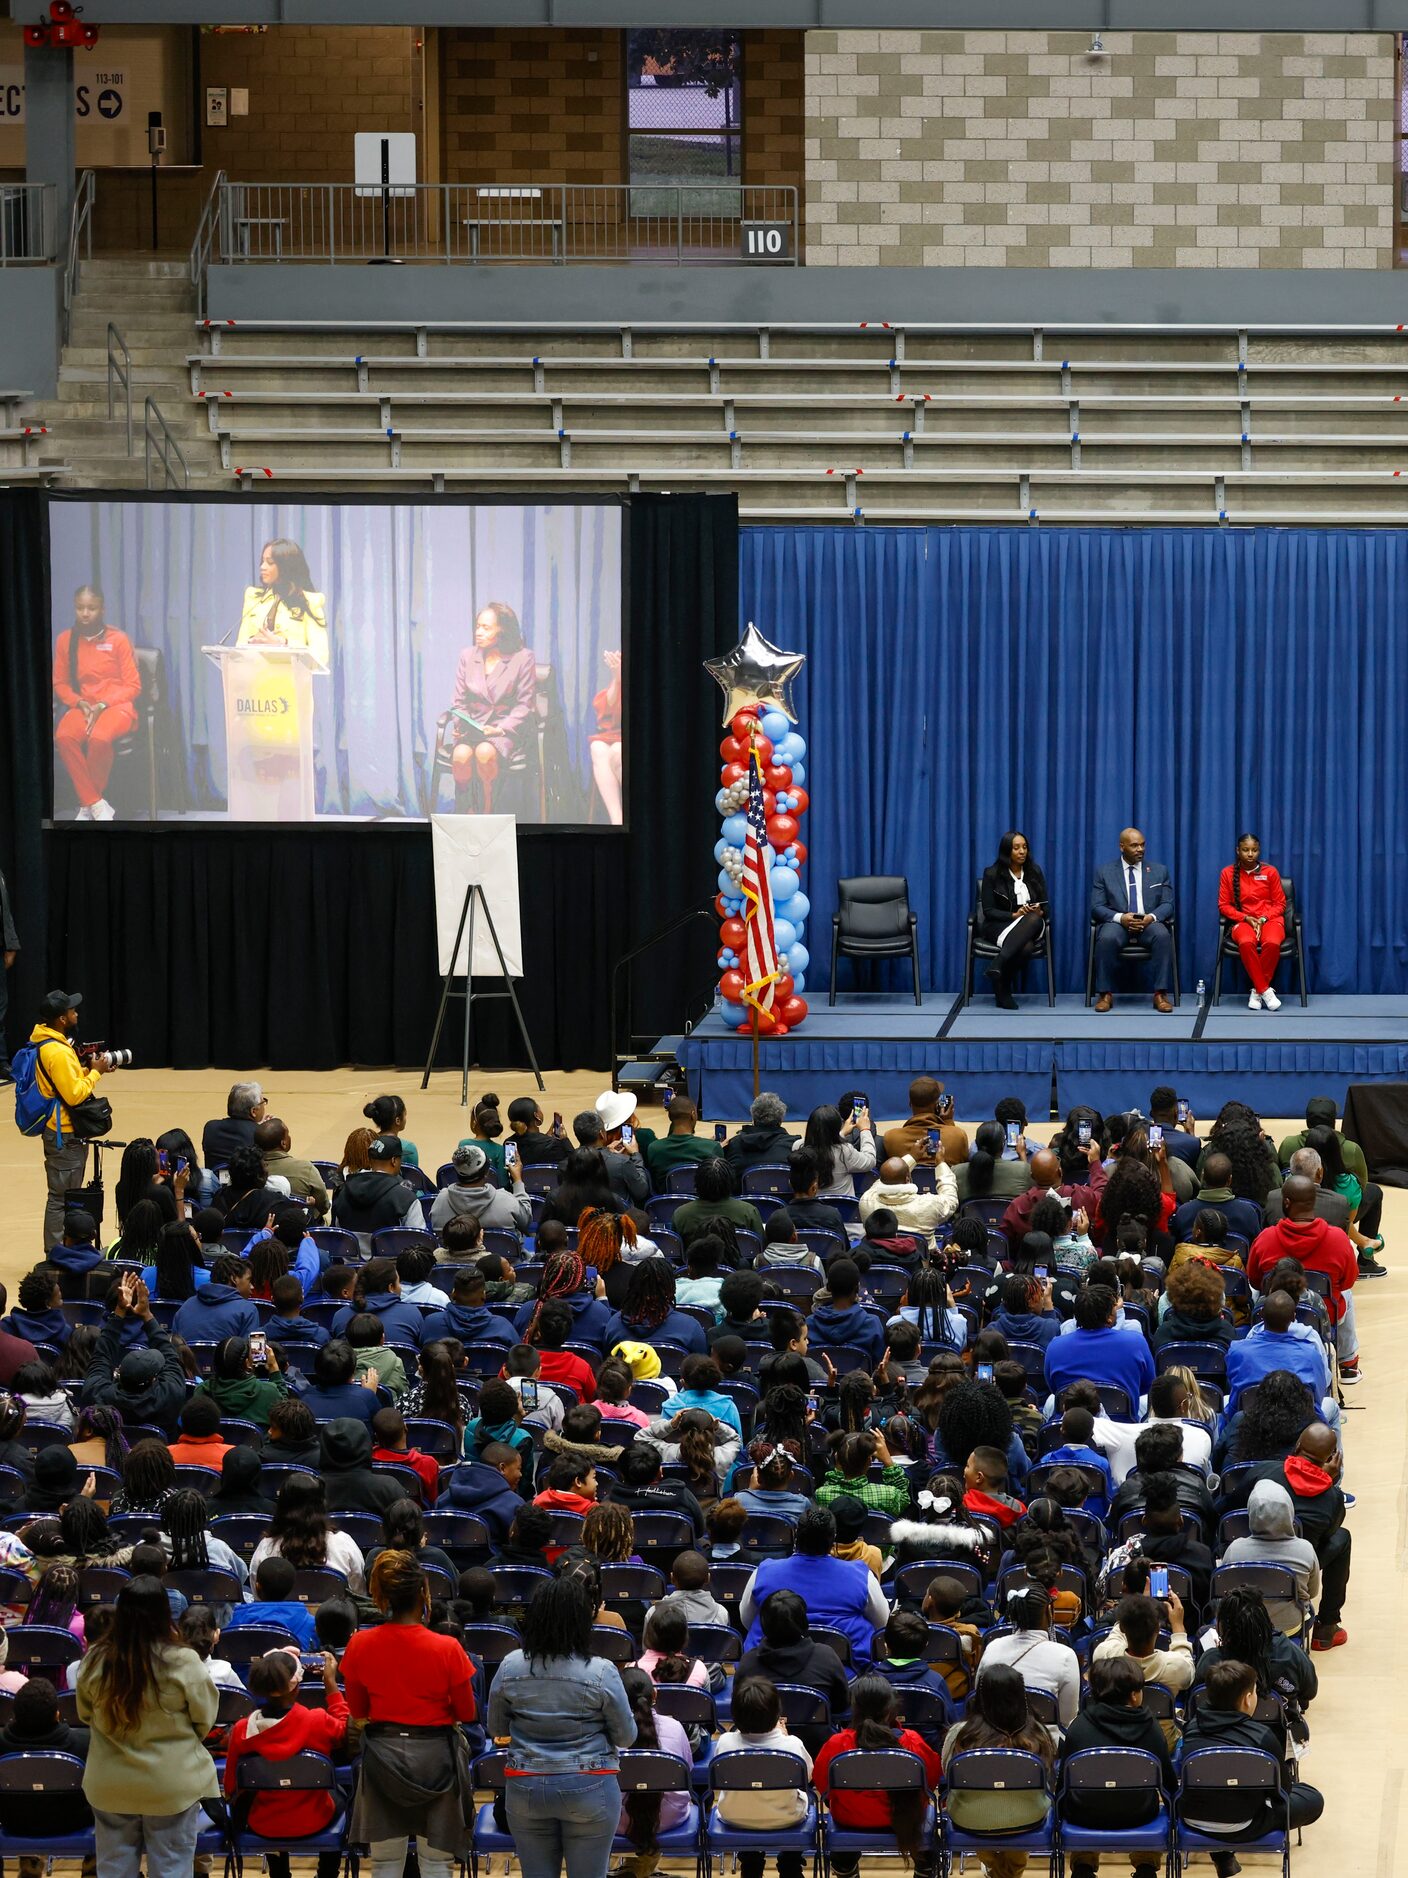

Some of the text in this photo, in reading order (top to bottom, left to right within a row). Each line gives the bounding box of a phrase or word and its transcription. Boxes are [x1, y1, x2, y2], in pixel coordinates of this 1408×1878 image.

[96, 73, 124, 85] 113-101
[748, 229, 782, 253] 110
[237, 698, 278, 713] DALLAS
